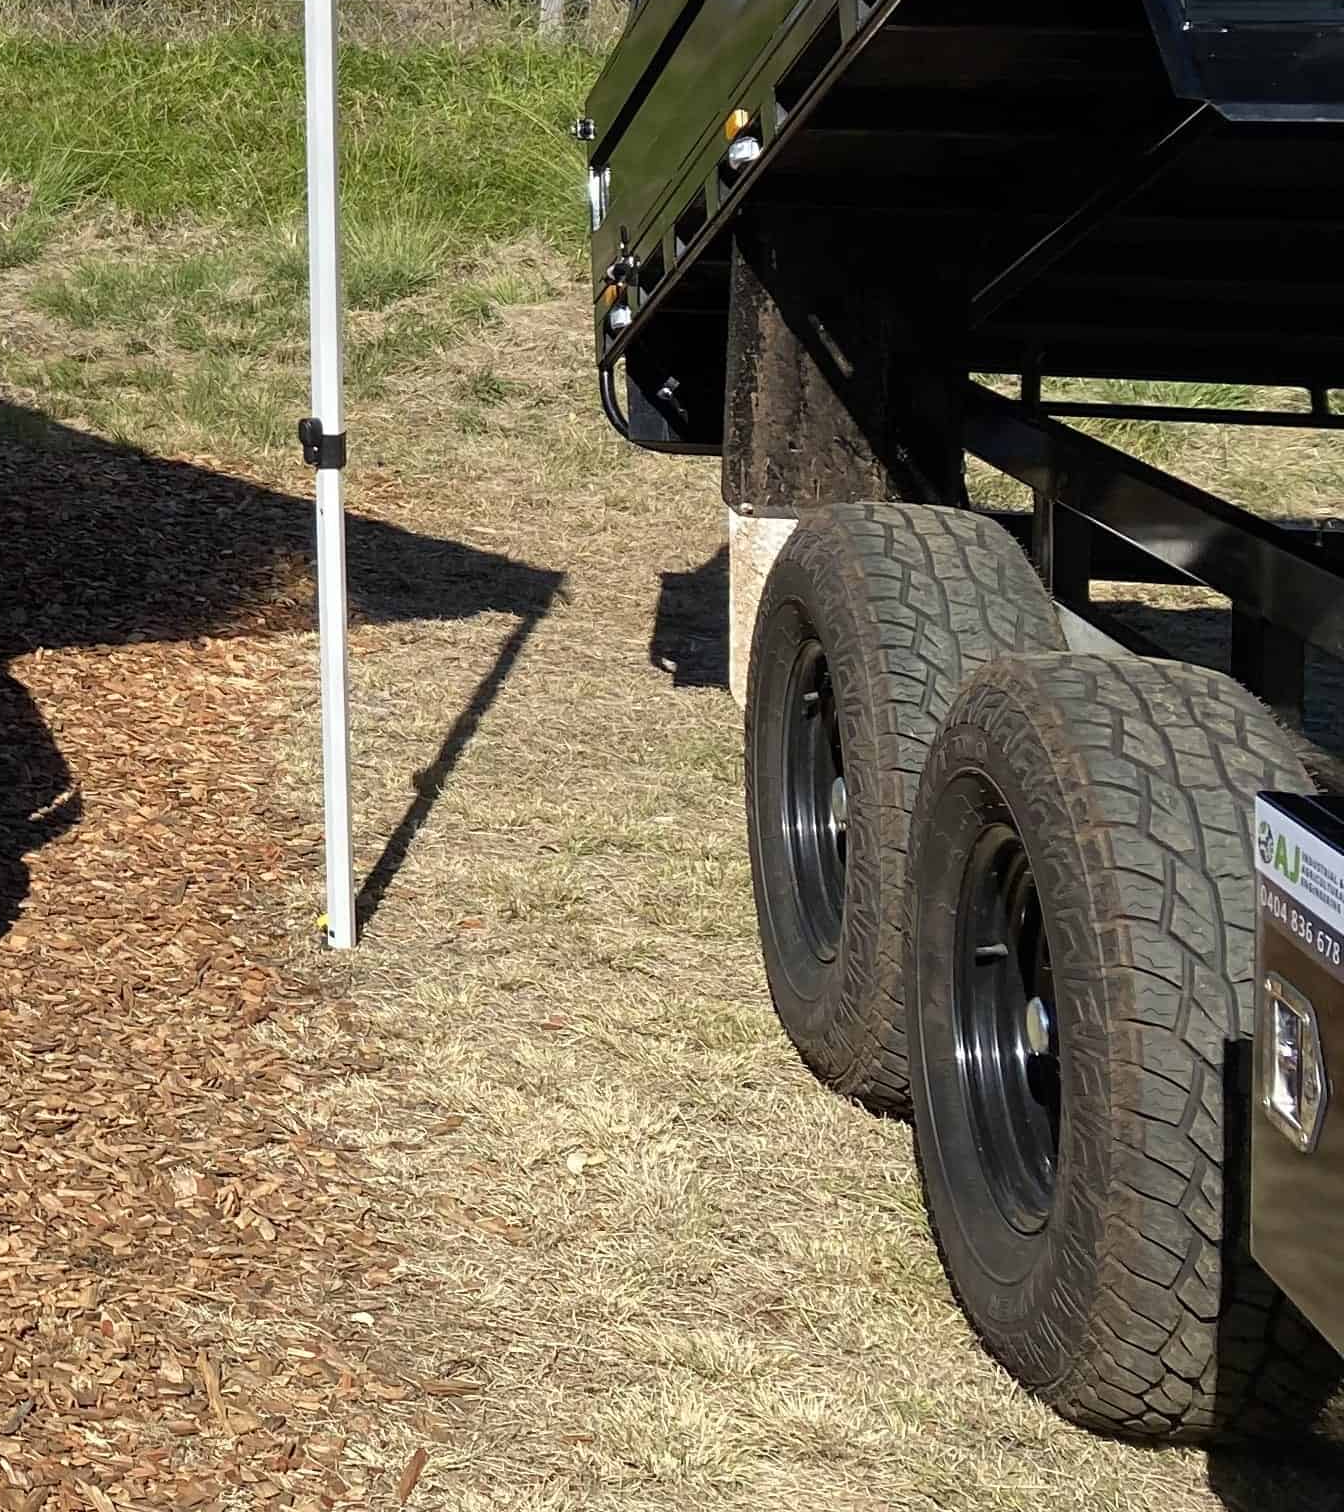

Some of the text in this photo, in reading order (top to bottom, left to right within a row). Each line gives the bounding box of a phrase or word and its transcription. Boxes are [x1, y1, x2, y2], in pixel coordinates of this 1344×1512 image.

[1274, 834, 1301, 884] AJ
[1302, 864, 1344, 903] AGRICULTURA
[1261, 885, 1341, 965] 0404 836 678
